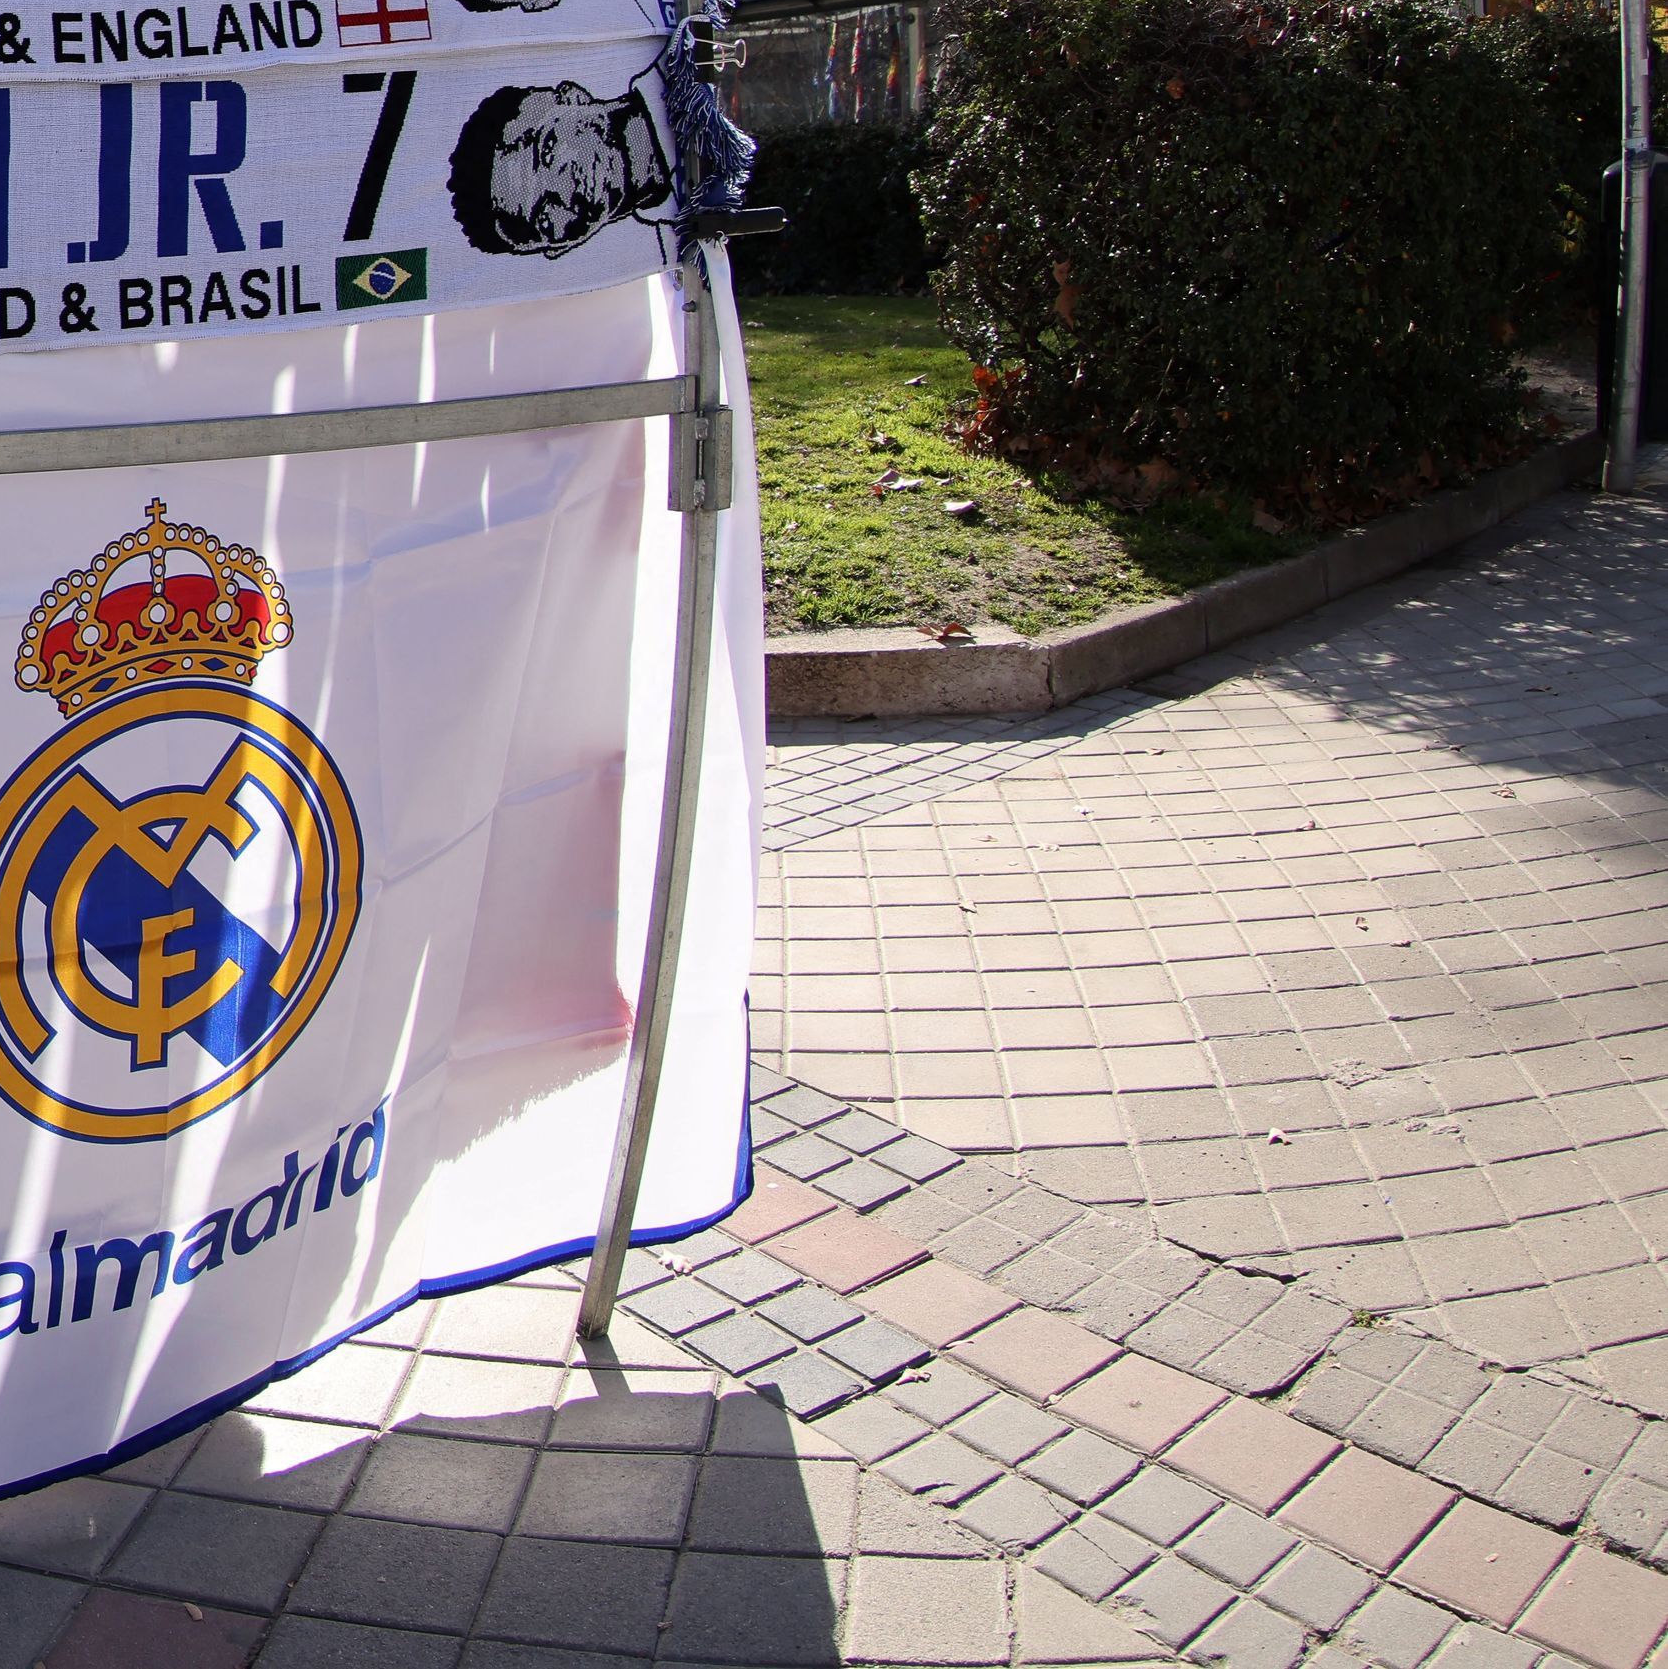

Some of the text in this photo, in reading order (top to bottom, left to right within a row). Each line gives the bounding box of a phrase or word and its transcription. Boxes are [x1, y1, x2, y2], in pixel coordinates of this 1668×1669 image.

[67, 81, 284, 264] JR.
[342, 70, 419, 243] 7
[59, 282, 97, 334] &
[119, 264, 322, 331] BRASIL
